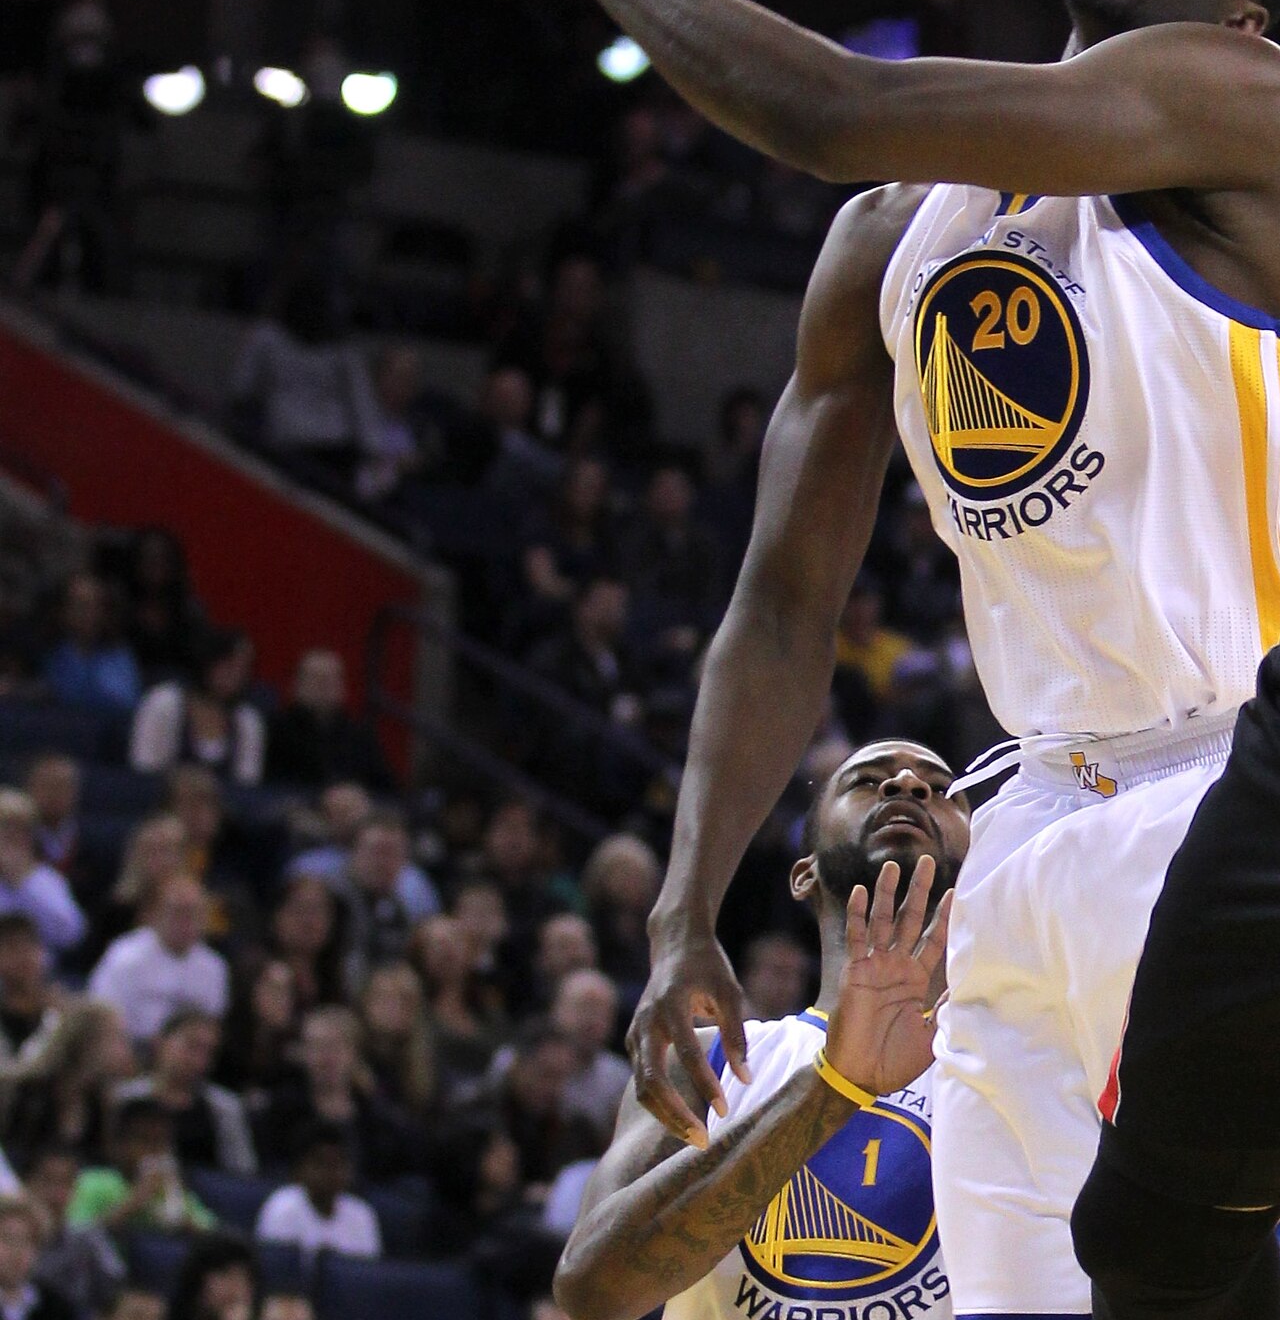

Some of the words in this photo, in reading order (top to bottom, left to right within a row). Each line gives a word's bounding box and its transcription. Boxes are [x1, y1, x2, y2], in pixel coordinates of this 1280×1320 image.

[969, 285, 1041, 353] 20
[946, 443, 1105, 541] ARRIORS
[861, 1139, 882, 1186] 1
